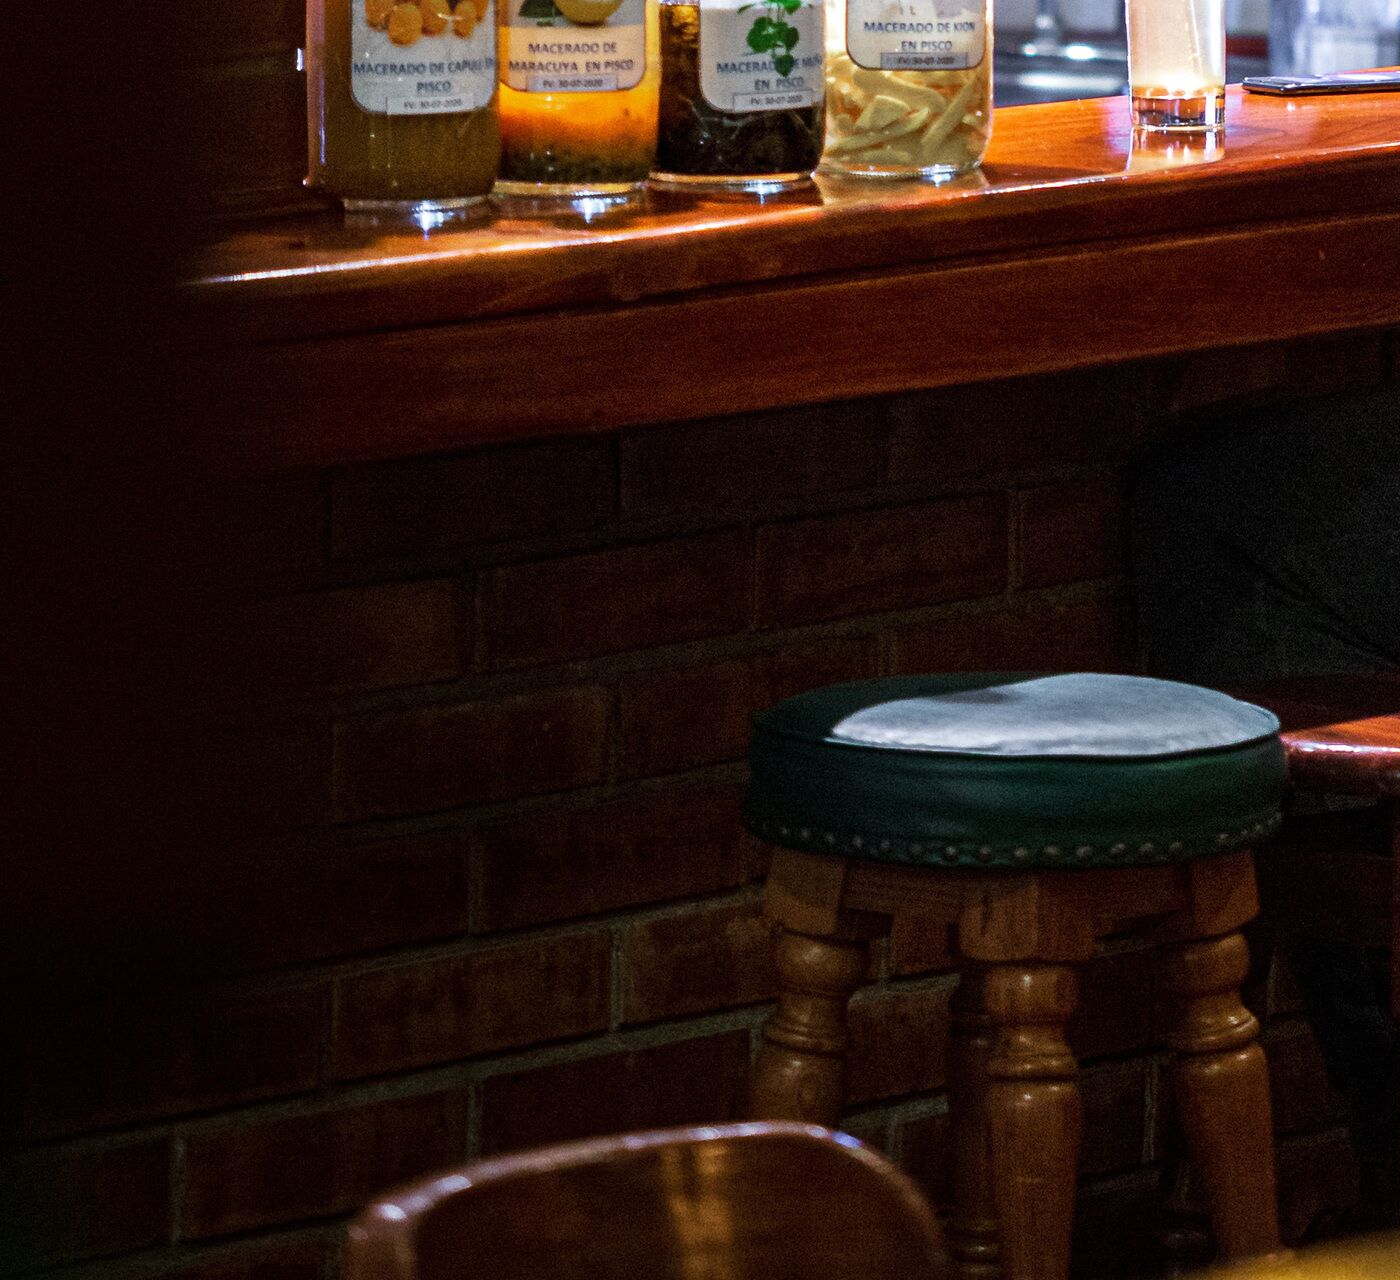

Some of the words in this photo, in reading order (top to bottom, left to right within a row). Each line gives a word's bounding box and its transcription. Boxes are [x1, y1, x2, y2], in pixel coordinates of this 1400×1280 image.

[863, 22, 934, 33] MACERADO
[937, 22, 951, 32] DE
[954, 21, 975, 32] KION
[528, 43, 599, 54] MACERADO
[603, 42, 617, 53] DE
[901, 40, 917, 50] EN
[921, 40, 953, 51] PISCO
[353, 62, 427, 75] MACERADO
[429, 62, 445, 74] DE
[509, 60, 579, 73] MARACUYA
[585, 60, 601, 72] EN
[604, 59, 634, 71] PISCO
[416, 80, 452, 92] PISCO
[754, 79, 770, 91] EN
[776, 77, 805, 89] PISCO
